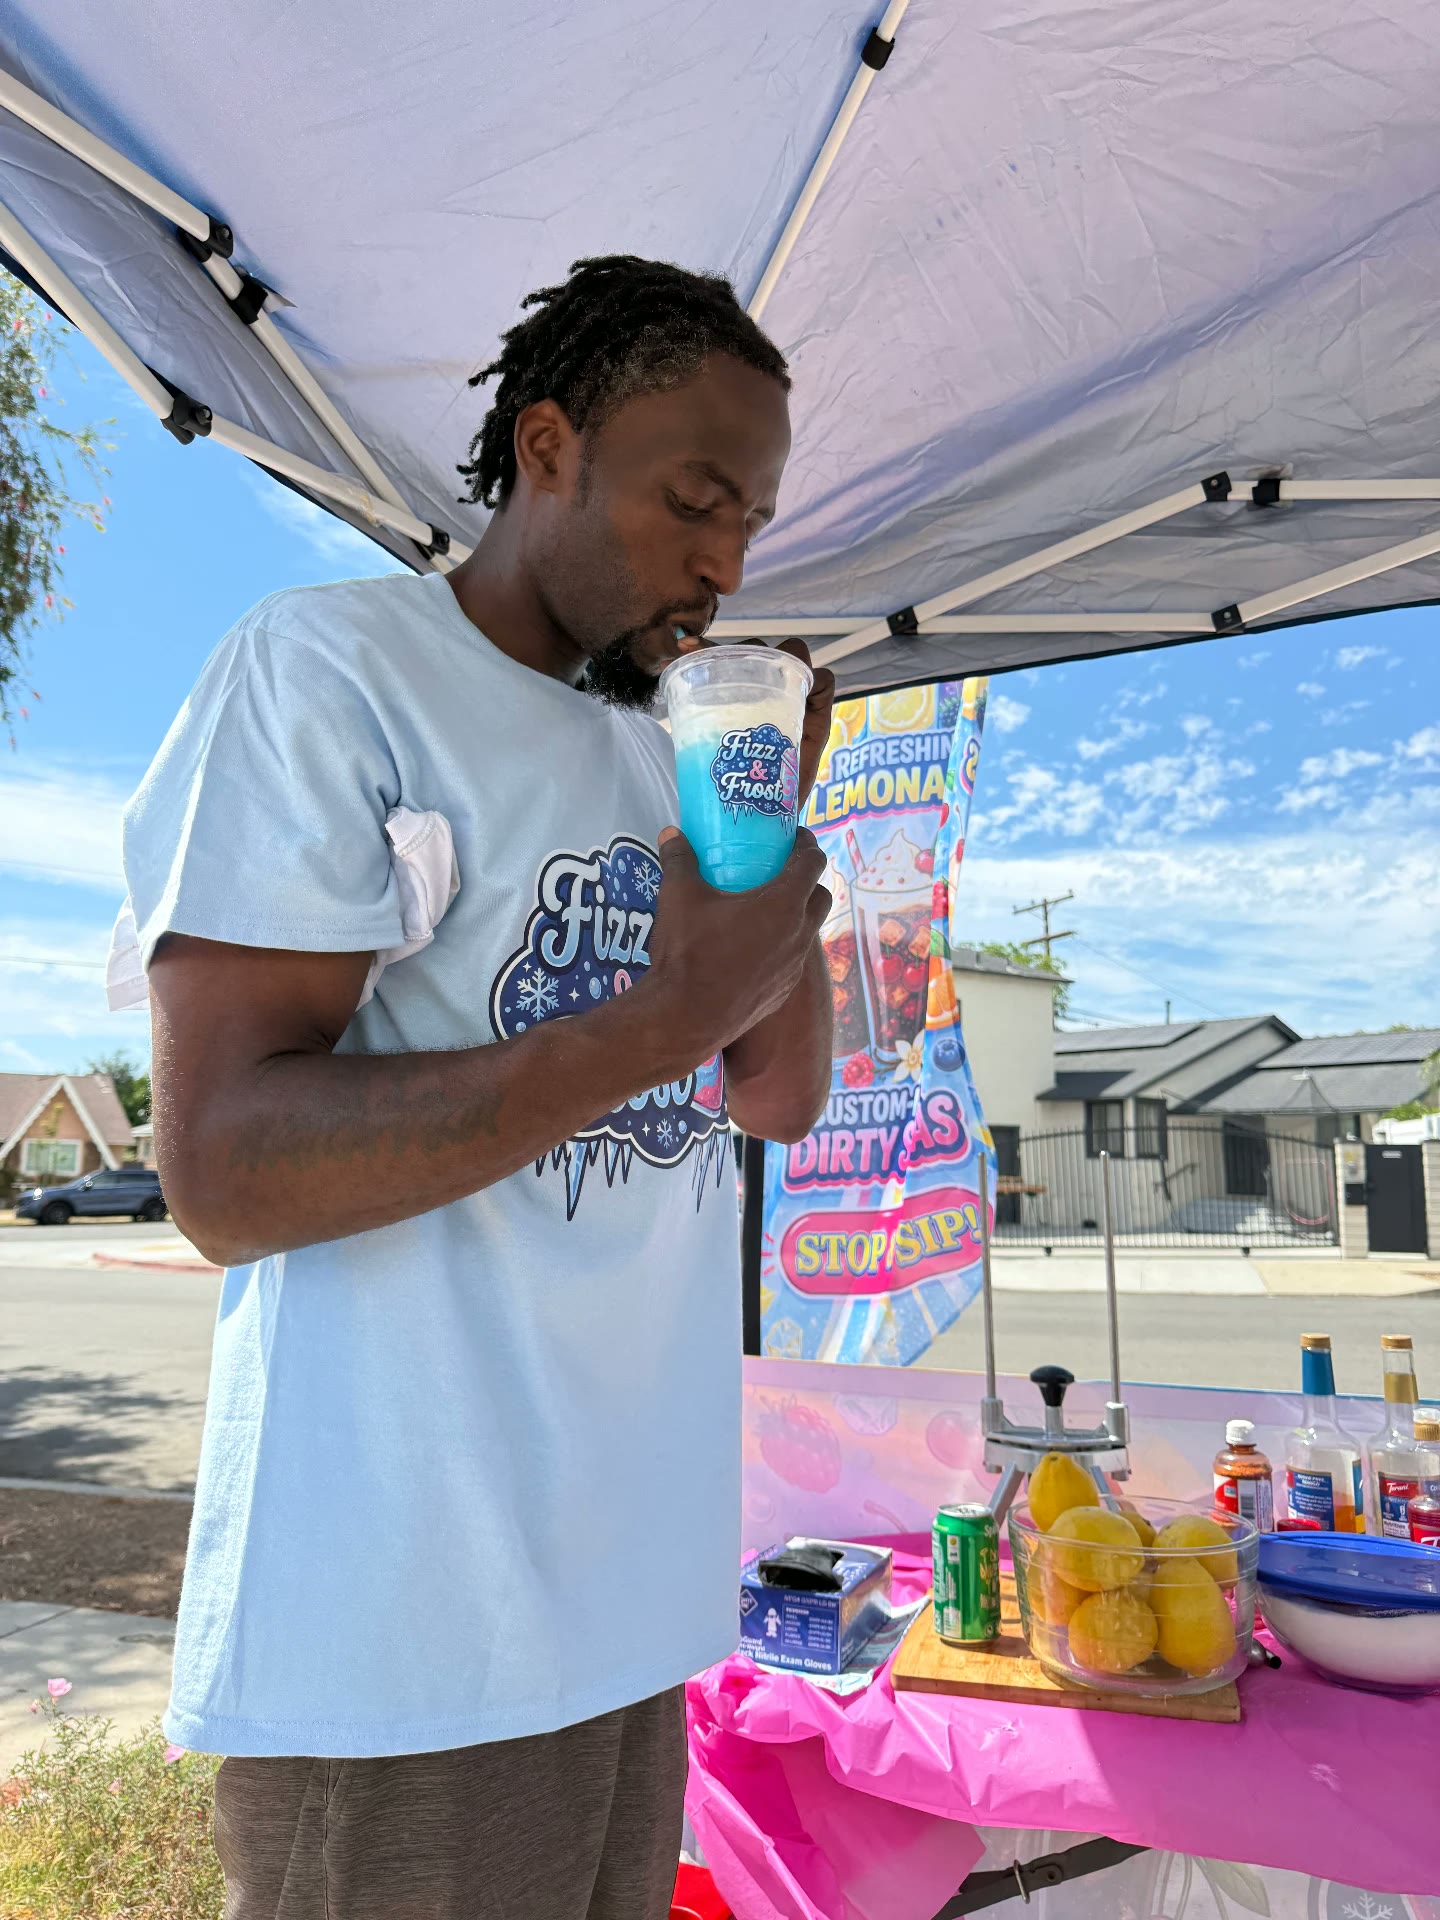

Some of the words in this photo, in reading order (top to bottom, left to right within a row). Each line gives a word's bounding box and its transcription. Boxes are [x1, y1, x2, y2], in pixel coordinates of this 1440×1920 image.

[722, 730, 778, 761] Fizz
[720, 772, 784, 802] Frost
[750, 760, 768, 781] &
[806, 764, 944, 827] LEMONA
[541, 858, 654, 967] Fizz
[788, 1125, 900, 1178] DIRTY
[796, 1231, 887, 1276] STOP
[895, 1202, 981, 1268] SIP!
[755, 1651, 780, 1662] Nitrile
[780, 1654, 803, 1667] Exam
[803, 1658, 832, 1671] Gloves
